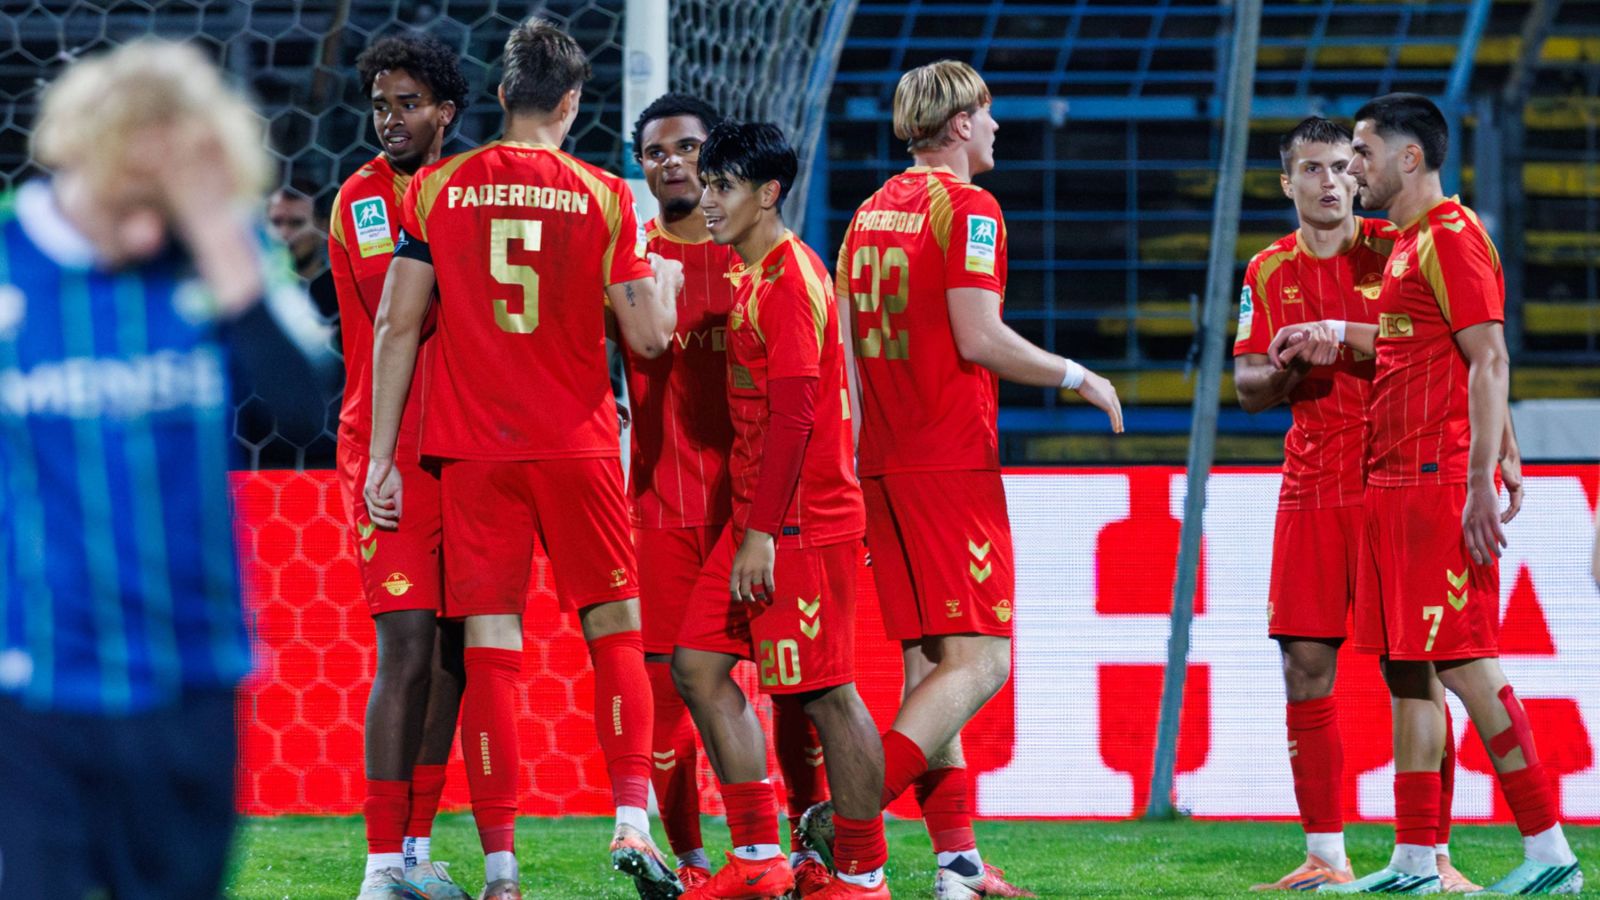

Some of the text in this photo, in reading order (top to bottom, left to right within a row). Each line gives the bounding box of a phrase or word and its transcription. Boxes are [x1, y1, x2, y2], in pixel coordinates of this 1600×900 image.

[447, 184, 589, 214] PADERBORN
[854, 209, 926, 234] PADERBORN
[490, 218, 543, 334] 5
[852, 245, 909, 360] 22
[1422, 605, 1444, 652] 7
[760, 638, 802, 686] 20
